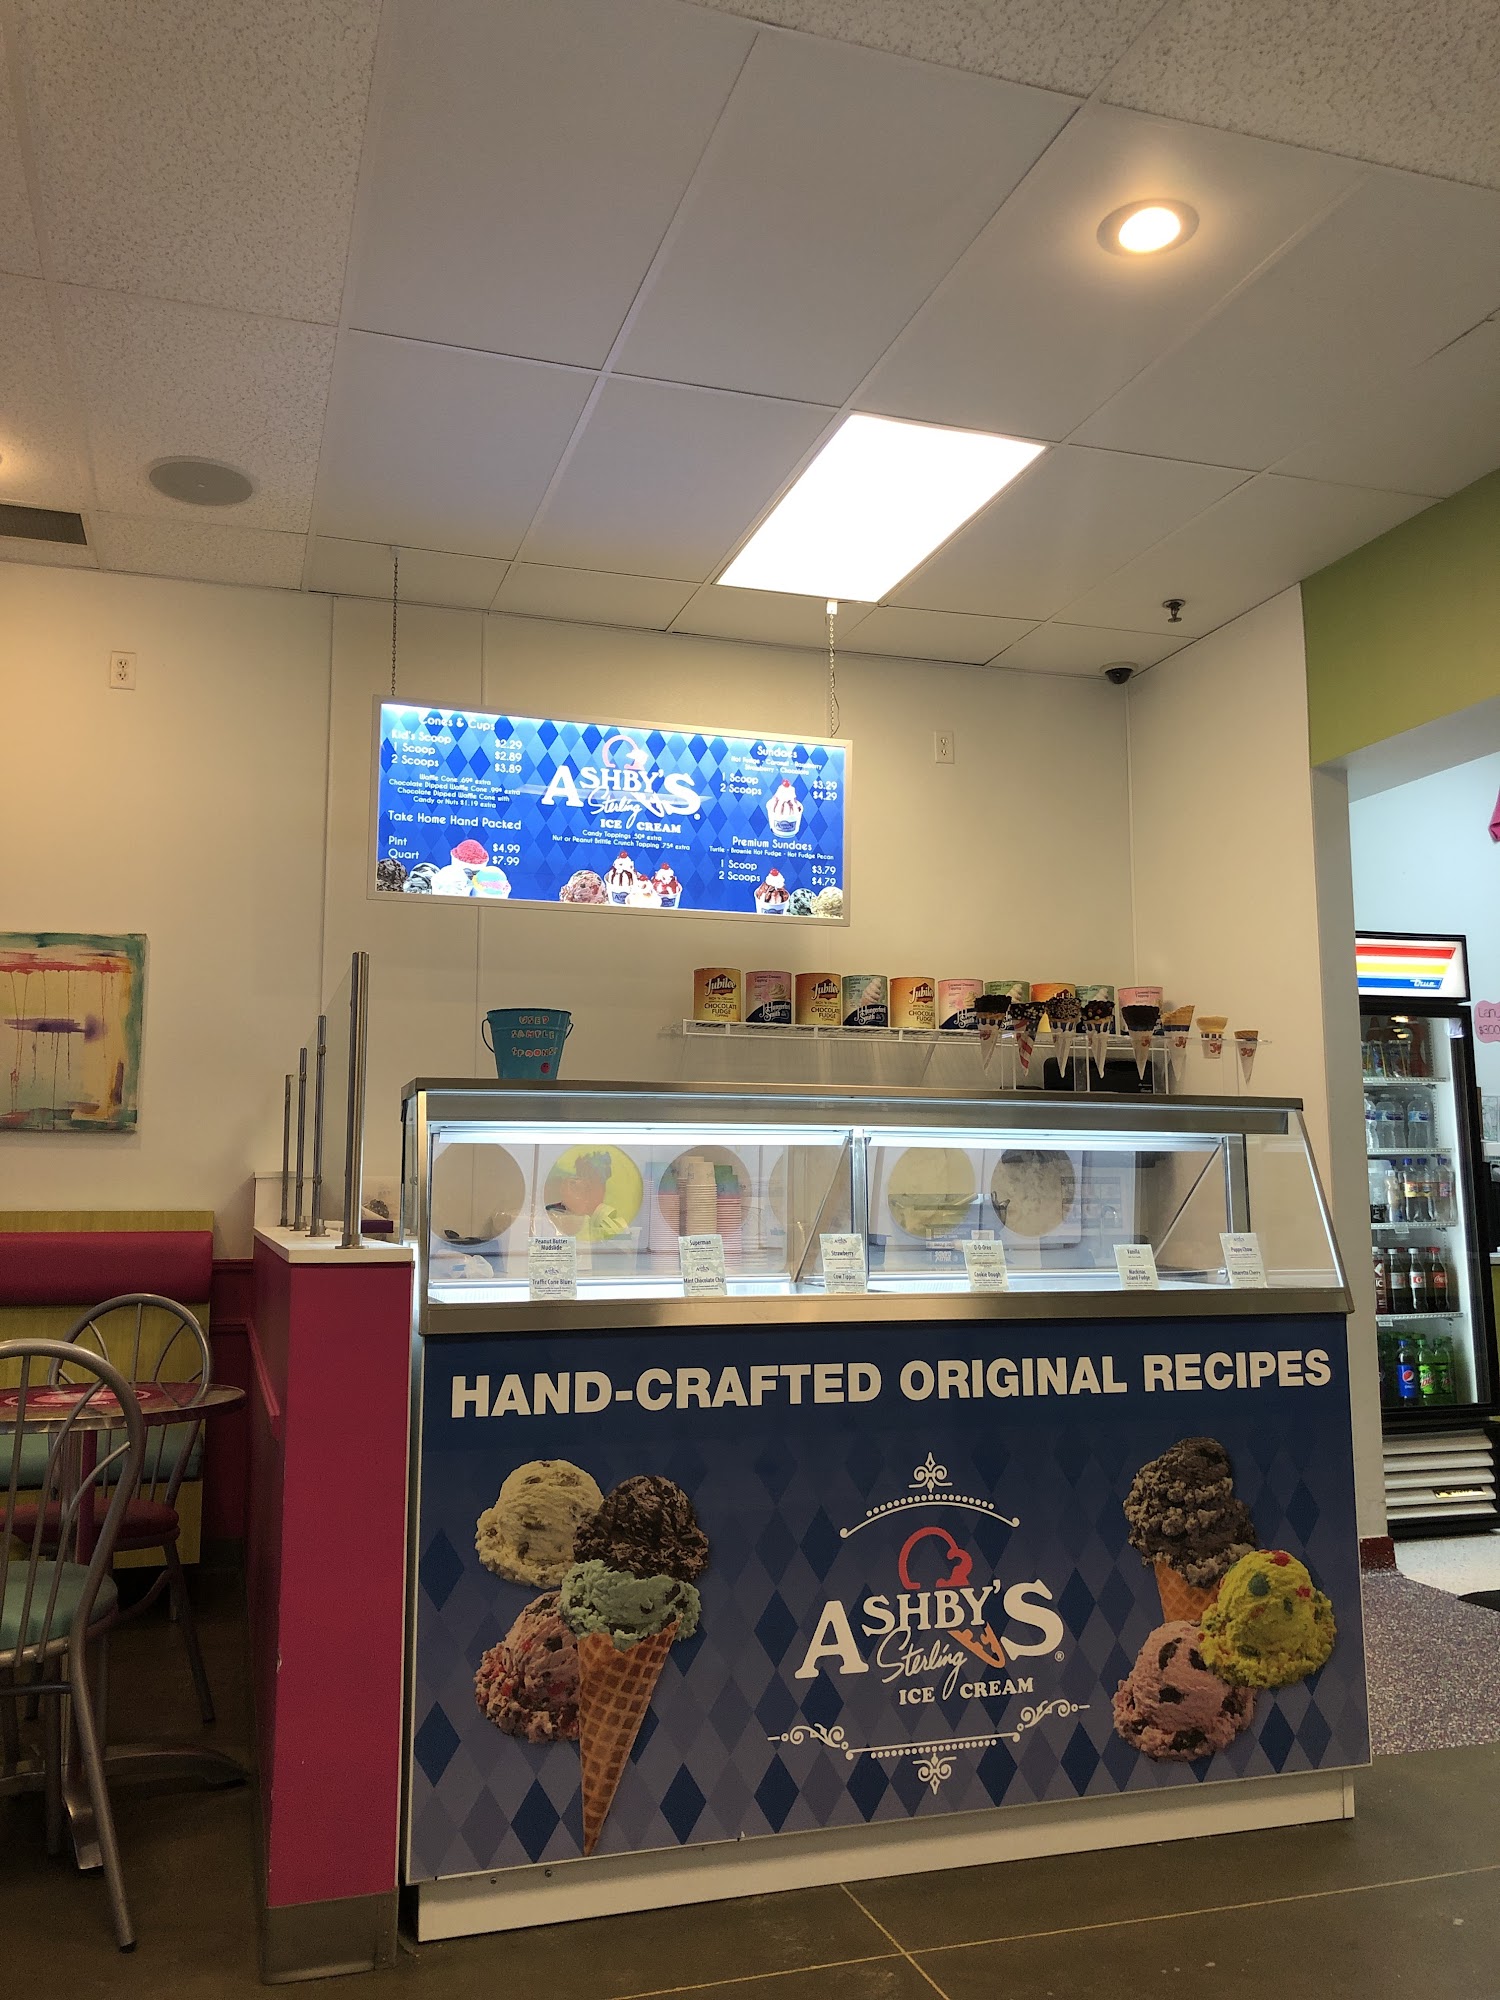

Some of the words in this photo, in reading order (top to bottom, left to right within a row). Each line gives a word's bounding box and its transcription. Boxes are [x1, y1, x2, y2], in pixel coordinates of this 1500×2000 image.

[420, 717, 453, 727] Cones
[456, 717, 464, 727] &
[468, 720, 495, 731] Cups
[391, 729, 415, 740] Kid's
[418, 731, 451, 744] Scoop
[494, 739, 522, 749] $2.29
[393, 742, 398, 751] 1
[402, 743, 436, 755] Scoop
[494, 751, 522, 761] $2.89
[757, 745, 797, 758] Sundaes
[391, 754, 398, 764] 2
[401, 755, 439, 768] Scoops
[494, 763, 522, 773] $3.89
[389, 779, 422, 788] Chocolate
[424, 781, 448, 790] Dipped
[449, 783, 469, 791] Waffle
[722, 772, 726, 781] 1
[729, 773, 759, 785] Scoop
[812, 780, 837, 790] $3.29
[397, 787, 431, 796] Chocolate
[433, 790, 457, 799] Dipped
[458, 792, 477, 800] Waffle
[541, 765, 700, 816] ASHBY'S
[720, 783, 726, 792] 2
[728, 784, 762, 796] Scoops
[812, 790, 837, 801] $4.29
[413, 796, 434, 805] Candy
[587, 786, 643, 830] Sterling
[388, 810, 413, 822] Take
[417, 812, 446, 825] Home
[450, 815, 478, 827] Hand
[482, 817, 521, 830] Packed
[601, 818, 622, 829] ICE
[636, 822, 681, 833] CREAM
[552, 834, 563, 842] Nut
[572, 836, 593, 844] Peanut
[613, 839, 634, 847] Crunch
[636, 841, 659, 850] Topping
[582, 830, 602, 838] Candy
[604, 831, 631, 840] Toppings
[732, 836, 769, 848] Premium
[772, 839, 812, 851] Sundaes
[388, 836, 408, 846] Pint
[492, 843, 520, 854] $4.99
[388, 848, 419, 860] Quart
[492, 855, 520, 866] $7.99
[720, 860, 724, 868] 1
[728, 859, 757, 871] Scoop
[811, 865, 836, 875] $3.79
[719, 871, 725, 880] 2
[727, 871, 760, 883] Scoops
[811, 877, 836, 887] $4.79
[704, 977, 737, 996] Jubilee
[1410, 979, 1437, 987] True
[511, 1029, 555, 1039] SAMPLE
[450, 1361, 883, 1419] HAND-CRAFTED
[899, 1355, 1128, 1401] ORIGINAL
[1143, 1348, 1332, 1393] RECIPES
[794, 1578, 1064, 1679] ASHBY'S
[876, 1624, 968, 1701] Sterling
[899, 1686, 936, 1705] ICE
[959, 1677, 1034, 1699] CREAM
